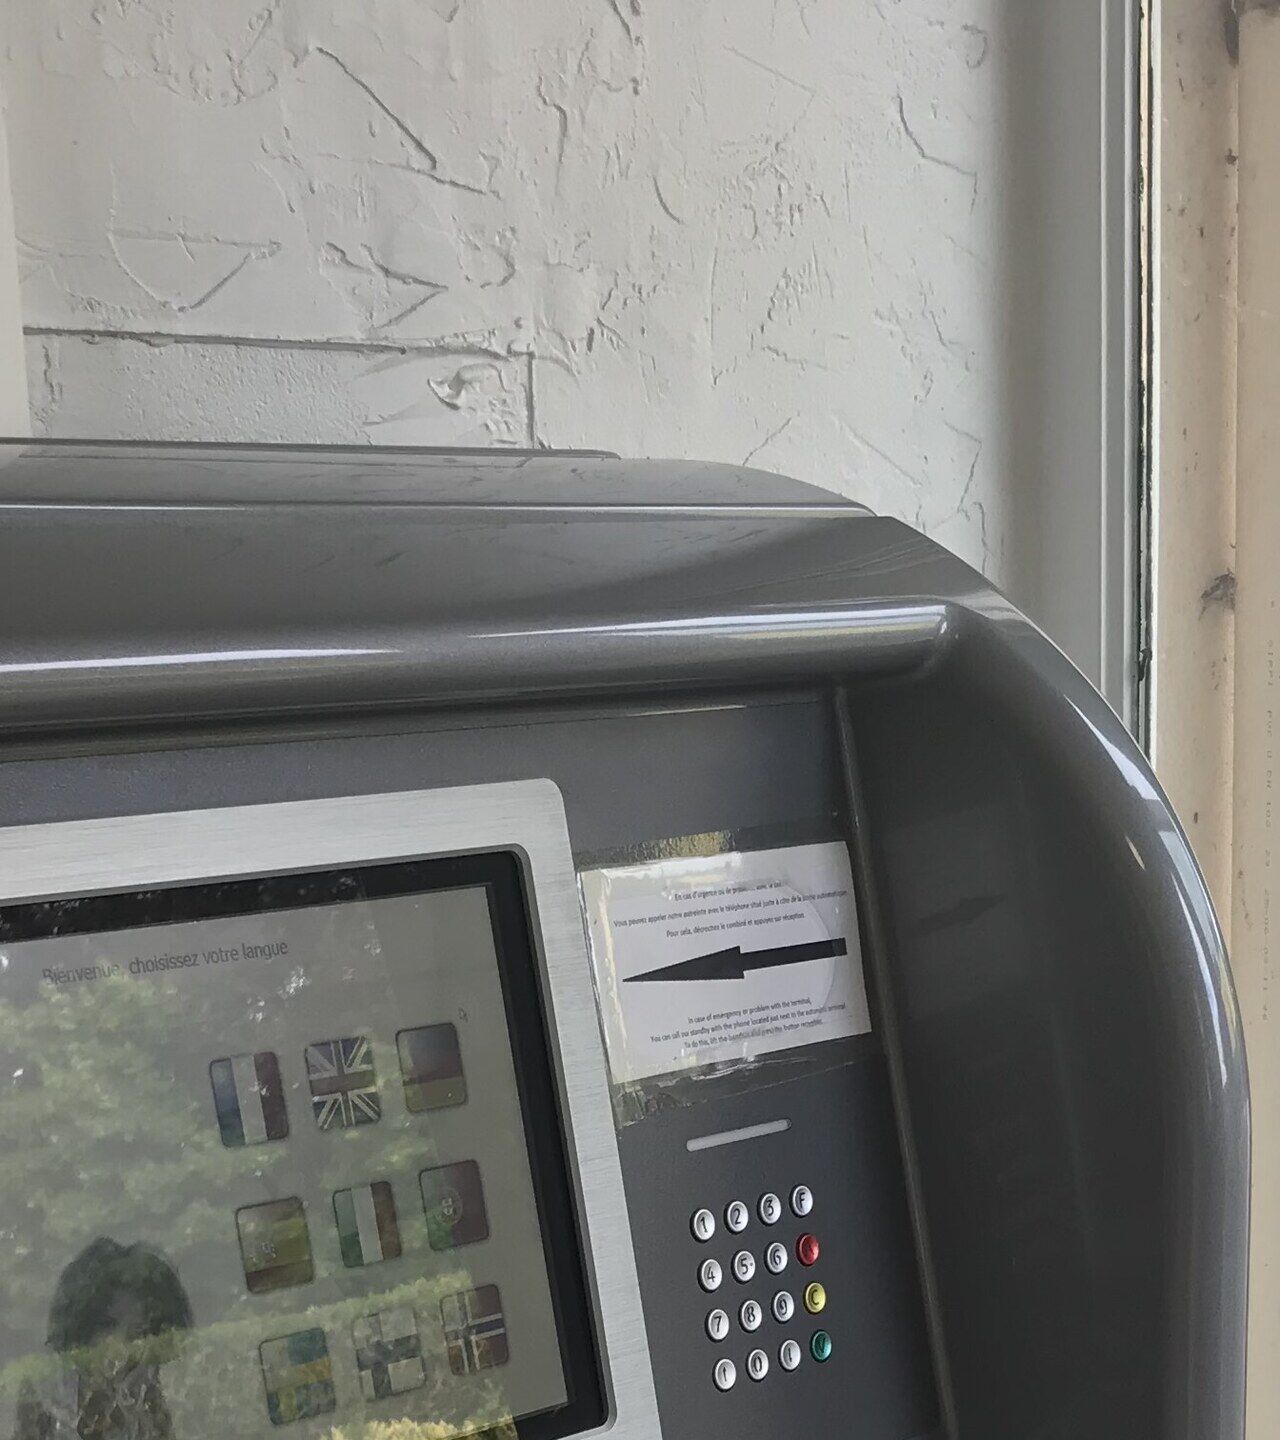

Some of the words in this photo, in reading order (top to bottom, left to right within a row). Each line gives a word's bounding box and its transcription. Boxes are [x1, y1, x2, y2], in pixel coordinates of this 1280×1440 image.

[129, 953, 201, 977] choisissez
[202, 949, 240, 965] votre
[241, 940, 289, 962] langue
[700, 1216, 708, 1233] 1
[733, 1208, 741, 1225] 2
[765, 1199, 774, 1216] 3
[707, 1264, 716, 1283] 4
[740, 1256, 749, 1274] 5
[773, 1249, 781, 1266] 6
[714, 1315, 723, 1333] 7
[747, 1306, 756, 1323] 8
[780, 1298, 788, 1316] 9
